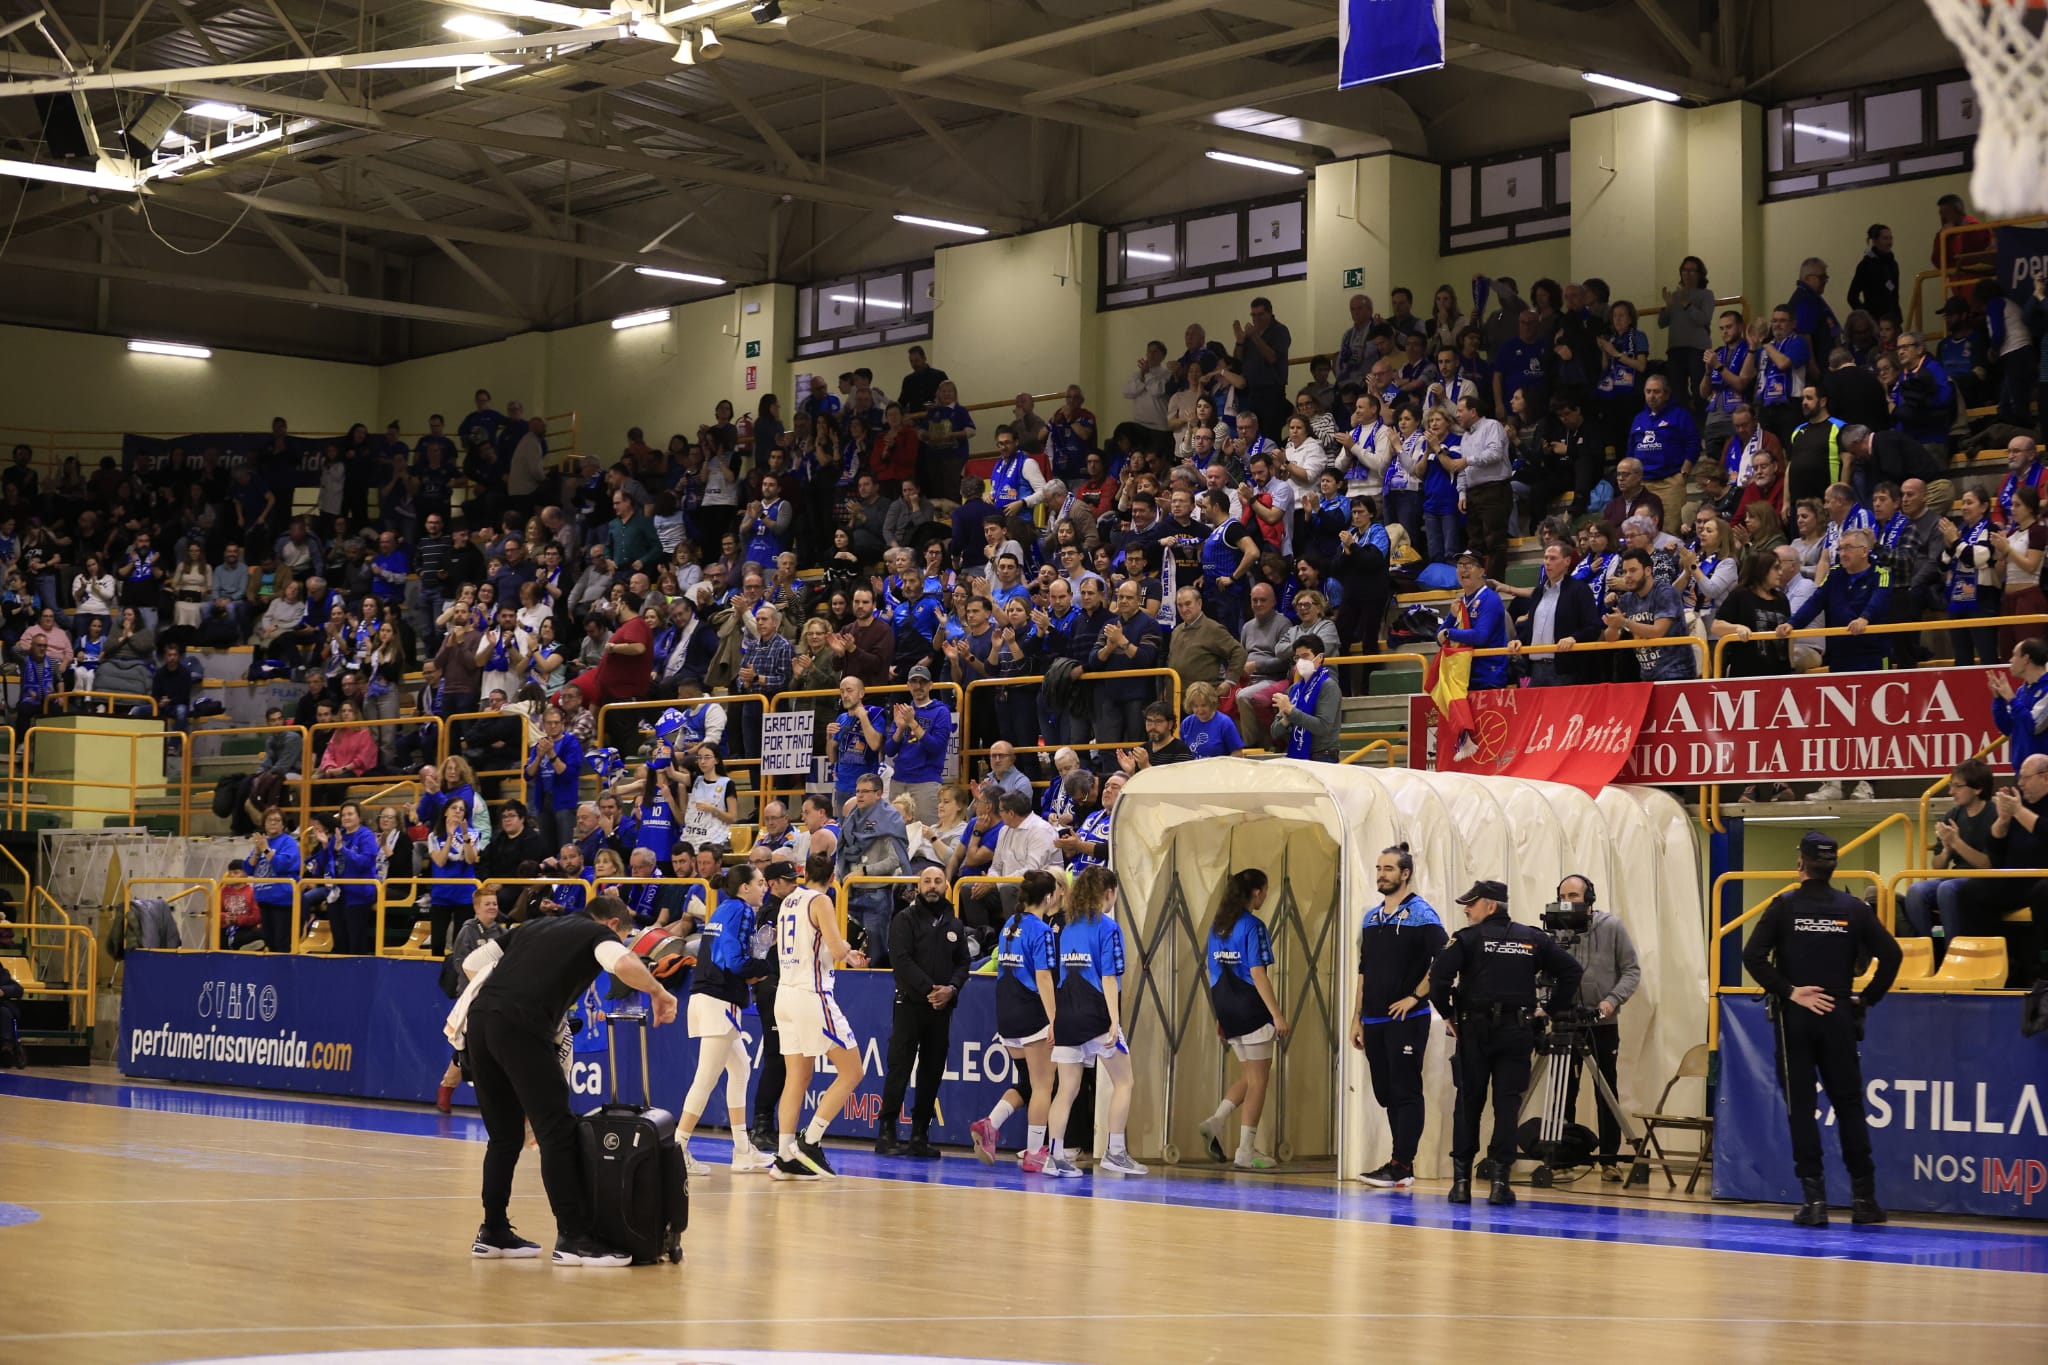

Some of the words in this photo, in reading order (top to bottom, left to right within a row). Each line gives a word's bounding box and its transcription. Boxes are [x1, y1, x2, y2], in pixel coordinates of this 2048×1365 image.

[764, 714, 814, 733] GRACIAS
[1524, 713, 1555, 754] La
[763, 735, 783, 751] POR
[784, 733, 813, 750] TANTO
[1688, 740, 1735, 776] DE
[1746, 739, 1790, 774] LA
[1800, 731, 2011, 772] HUMANIDA
[763, 752, 791, 770] MAGIC
[651, 805, 662, 817] 10
[780, 914, 797, 956] 13
[1794, 925, 1848, 933] NACIONAL
[130, 1022, 352, 1072] perfumeriasavenida.com
[1913, 1154, 1976, 1183] NOS
